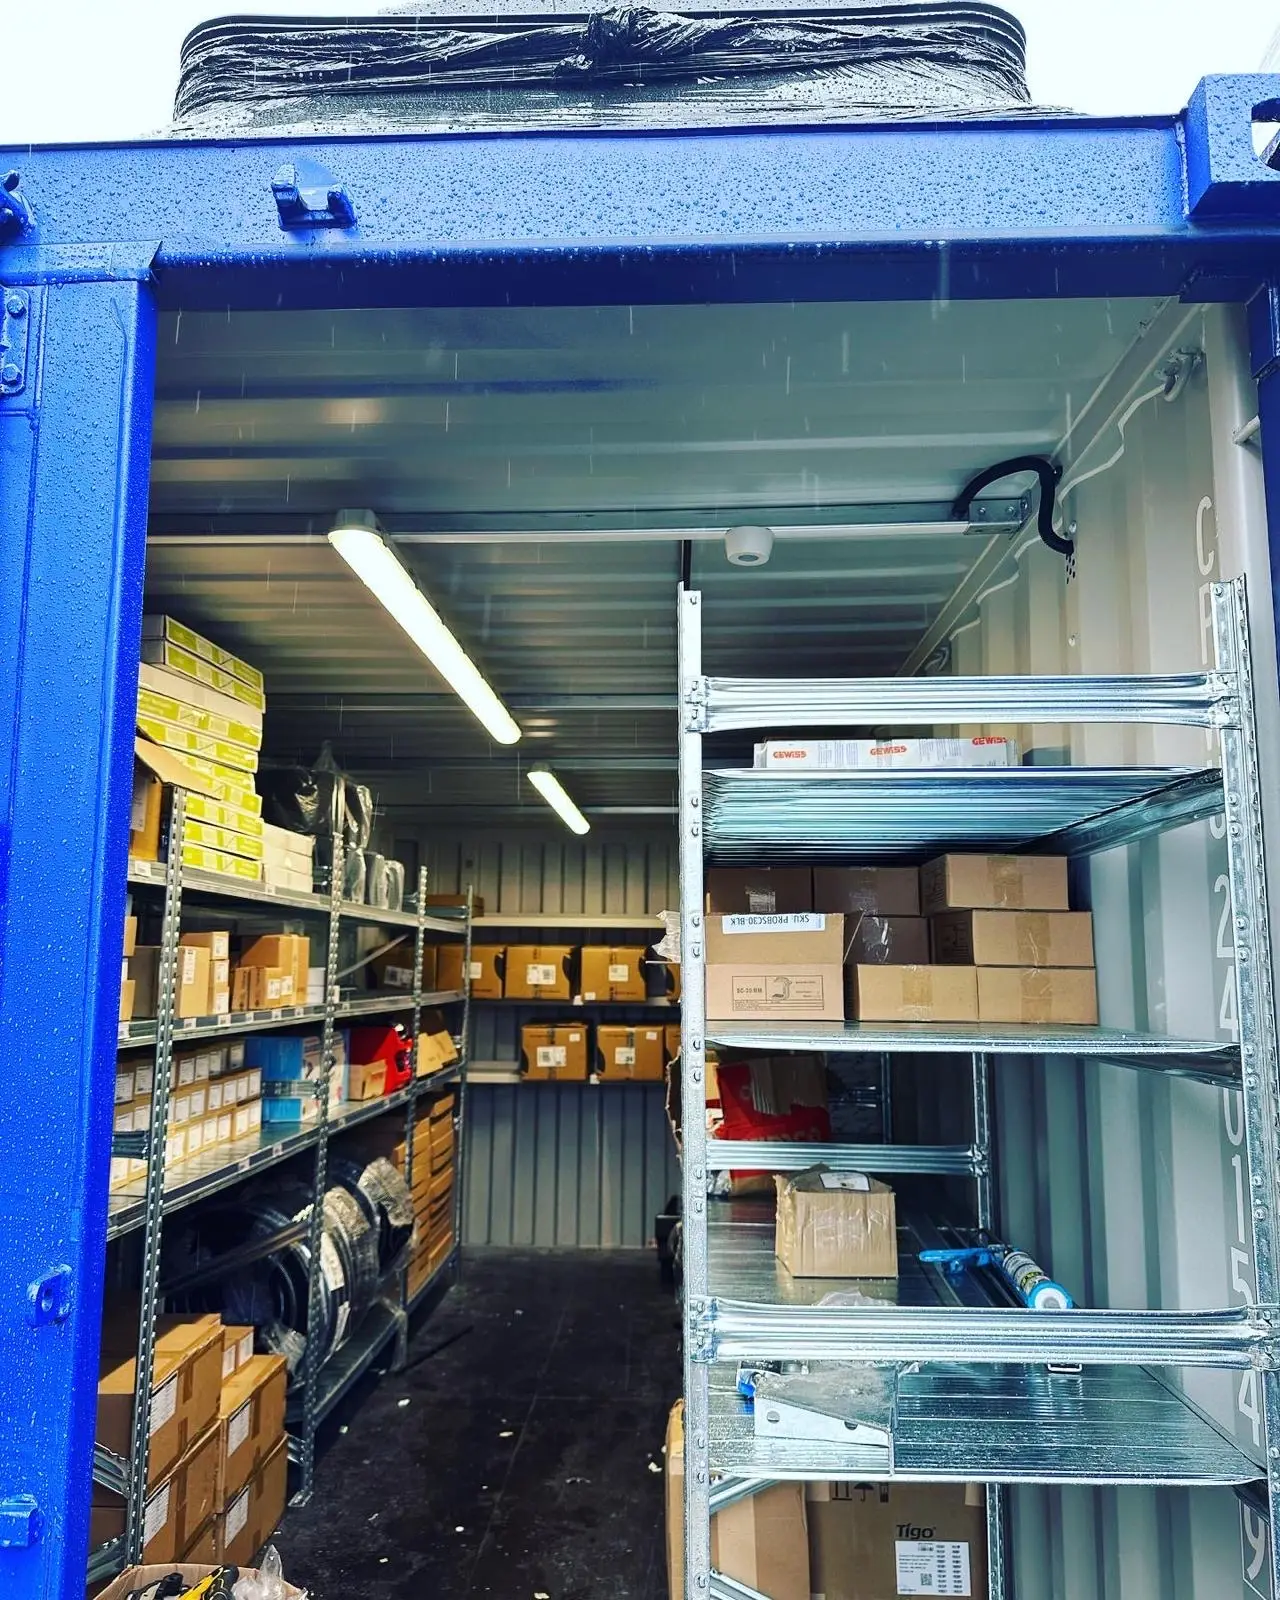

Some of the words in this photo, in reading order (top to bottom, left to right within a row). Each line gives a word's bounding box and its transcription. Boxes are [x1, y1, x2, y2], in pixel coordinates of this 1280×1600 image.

[972, 735, 1008, 746] GEWISS
[773, 750, 807, 759] GEWISS
[870, 745, 908, 756] GEWISS
[896, 1522, 935, 1540] Tigo
